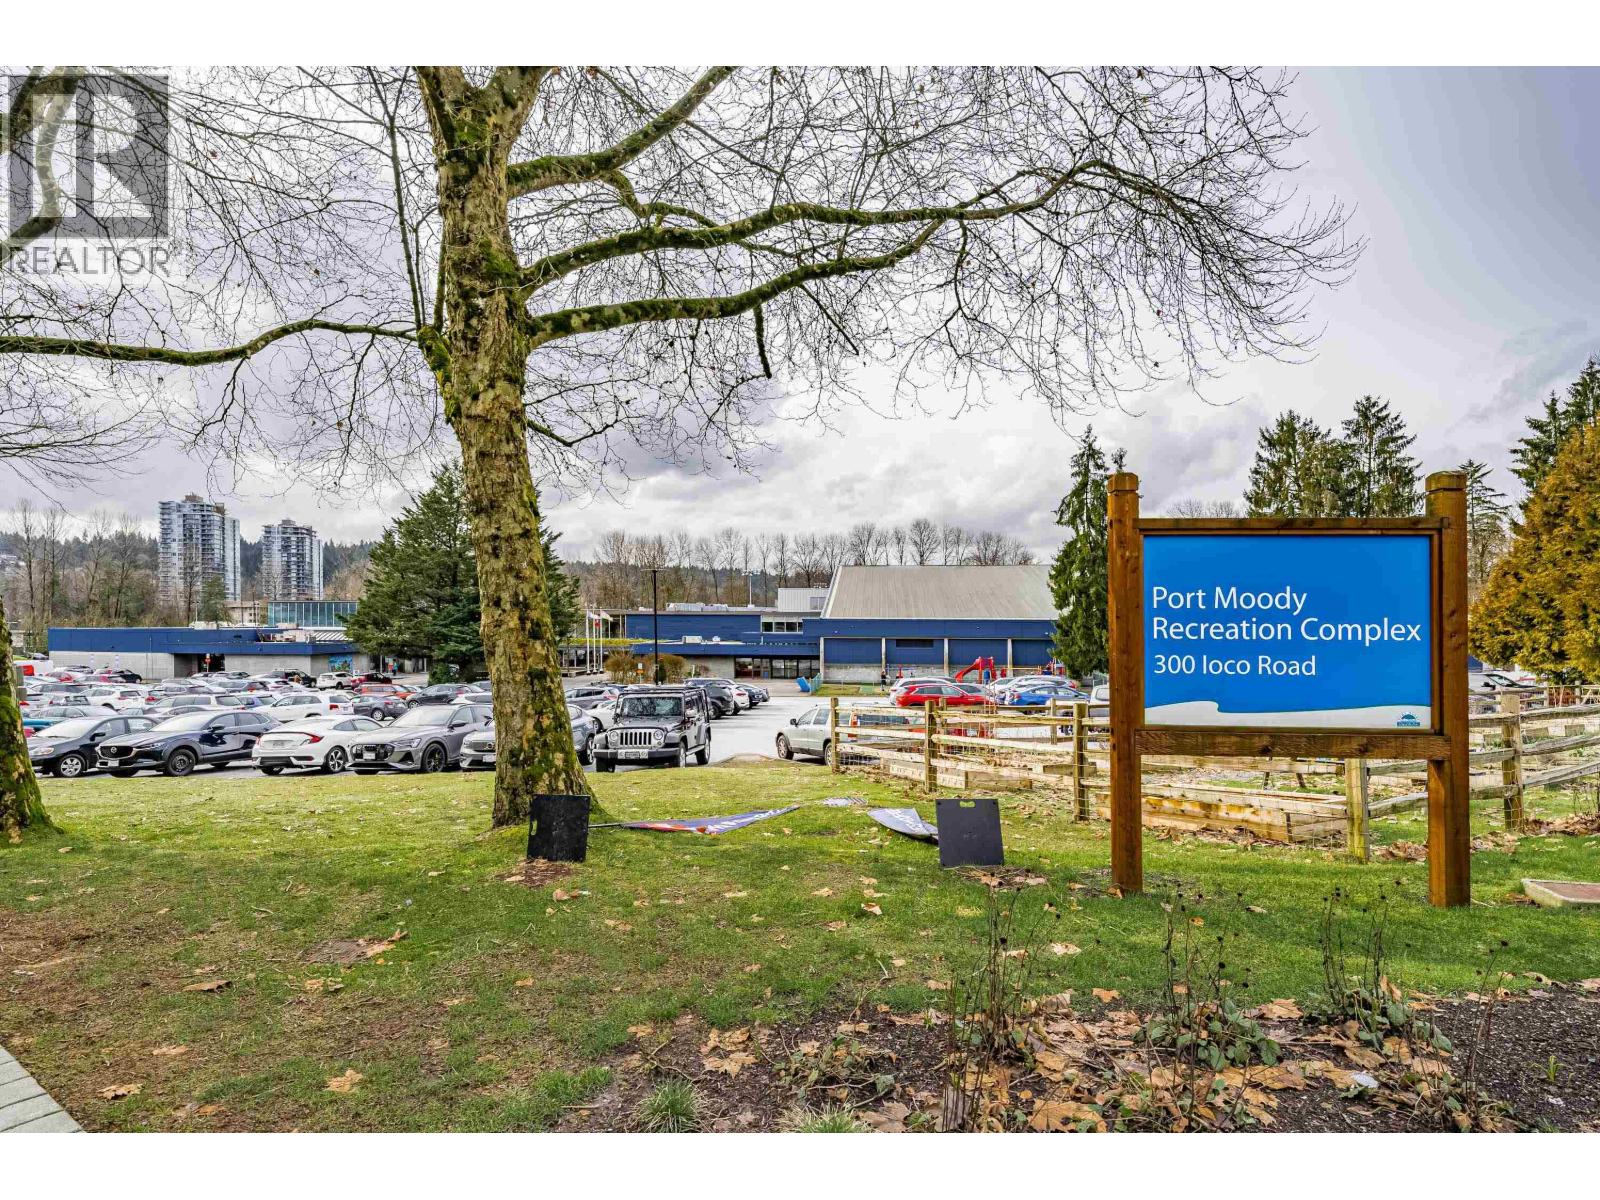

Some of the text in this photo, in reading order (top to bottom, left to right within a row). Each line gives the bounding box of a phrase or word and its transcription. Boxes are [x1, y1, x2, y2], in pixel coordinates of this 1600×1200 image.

[1153, 586, 1307, 616] Port Moody
[1153, 616, 1422, 647] Recreation Complex
[1154, 654, 1316, 676] 300 Ioco Road
